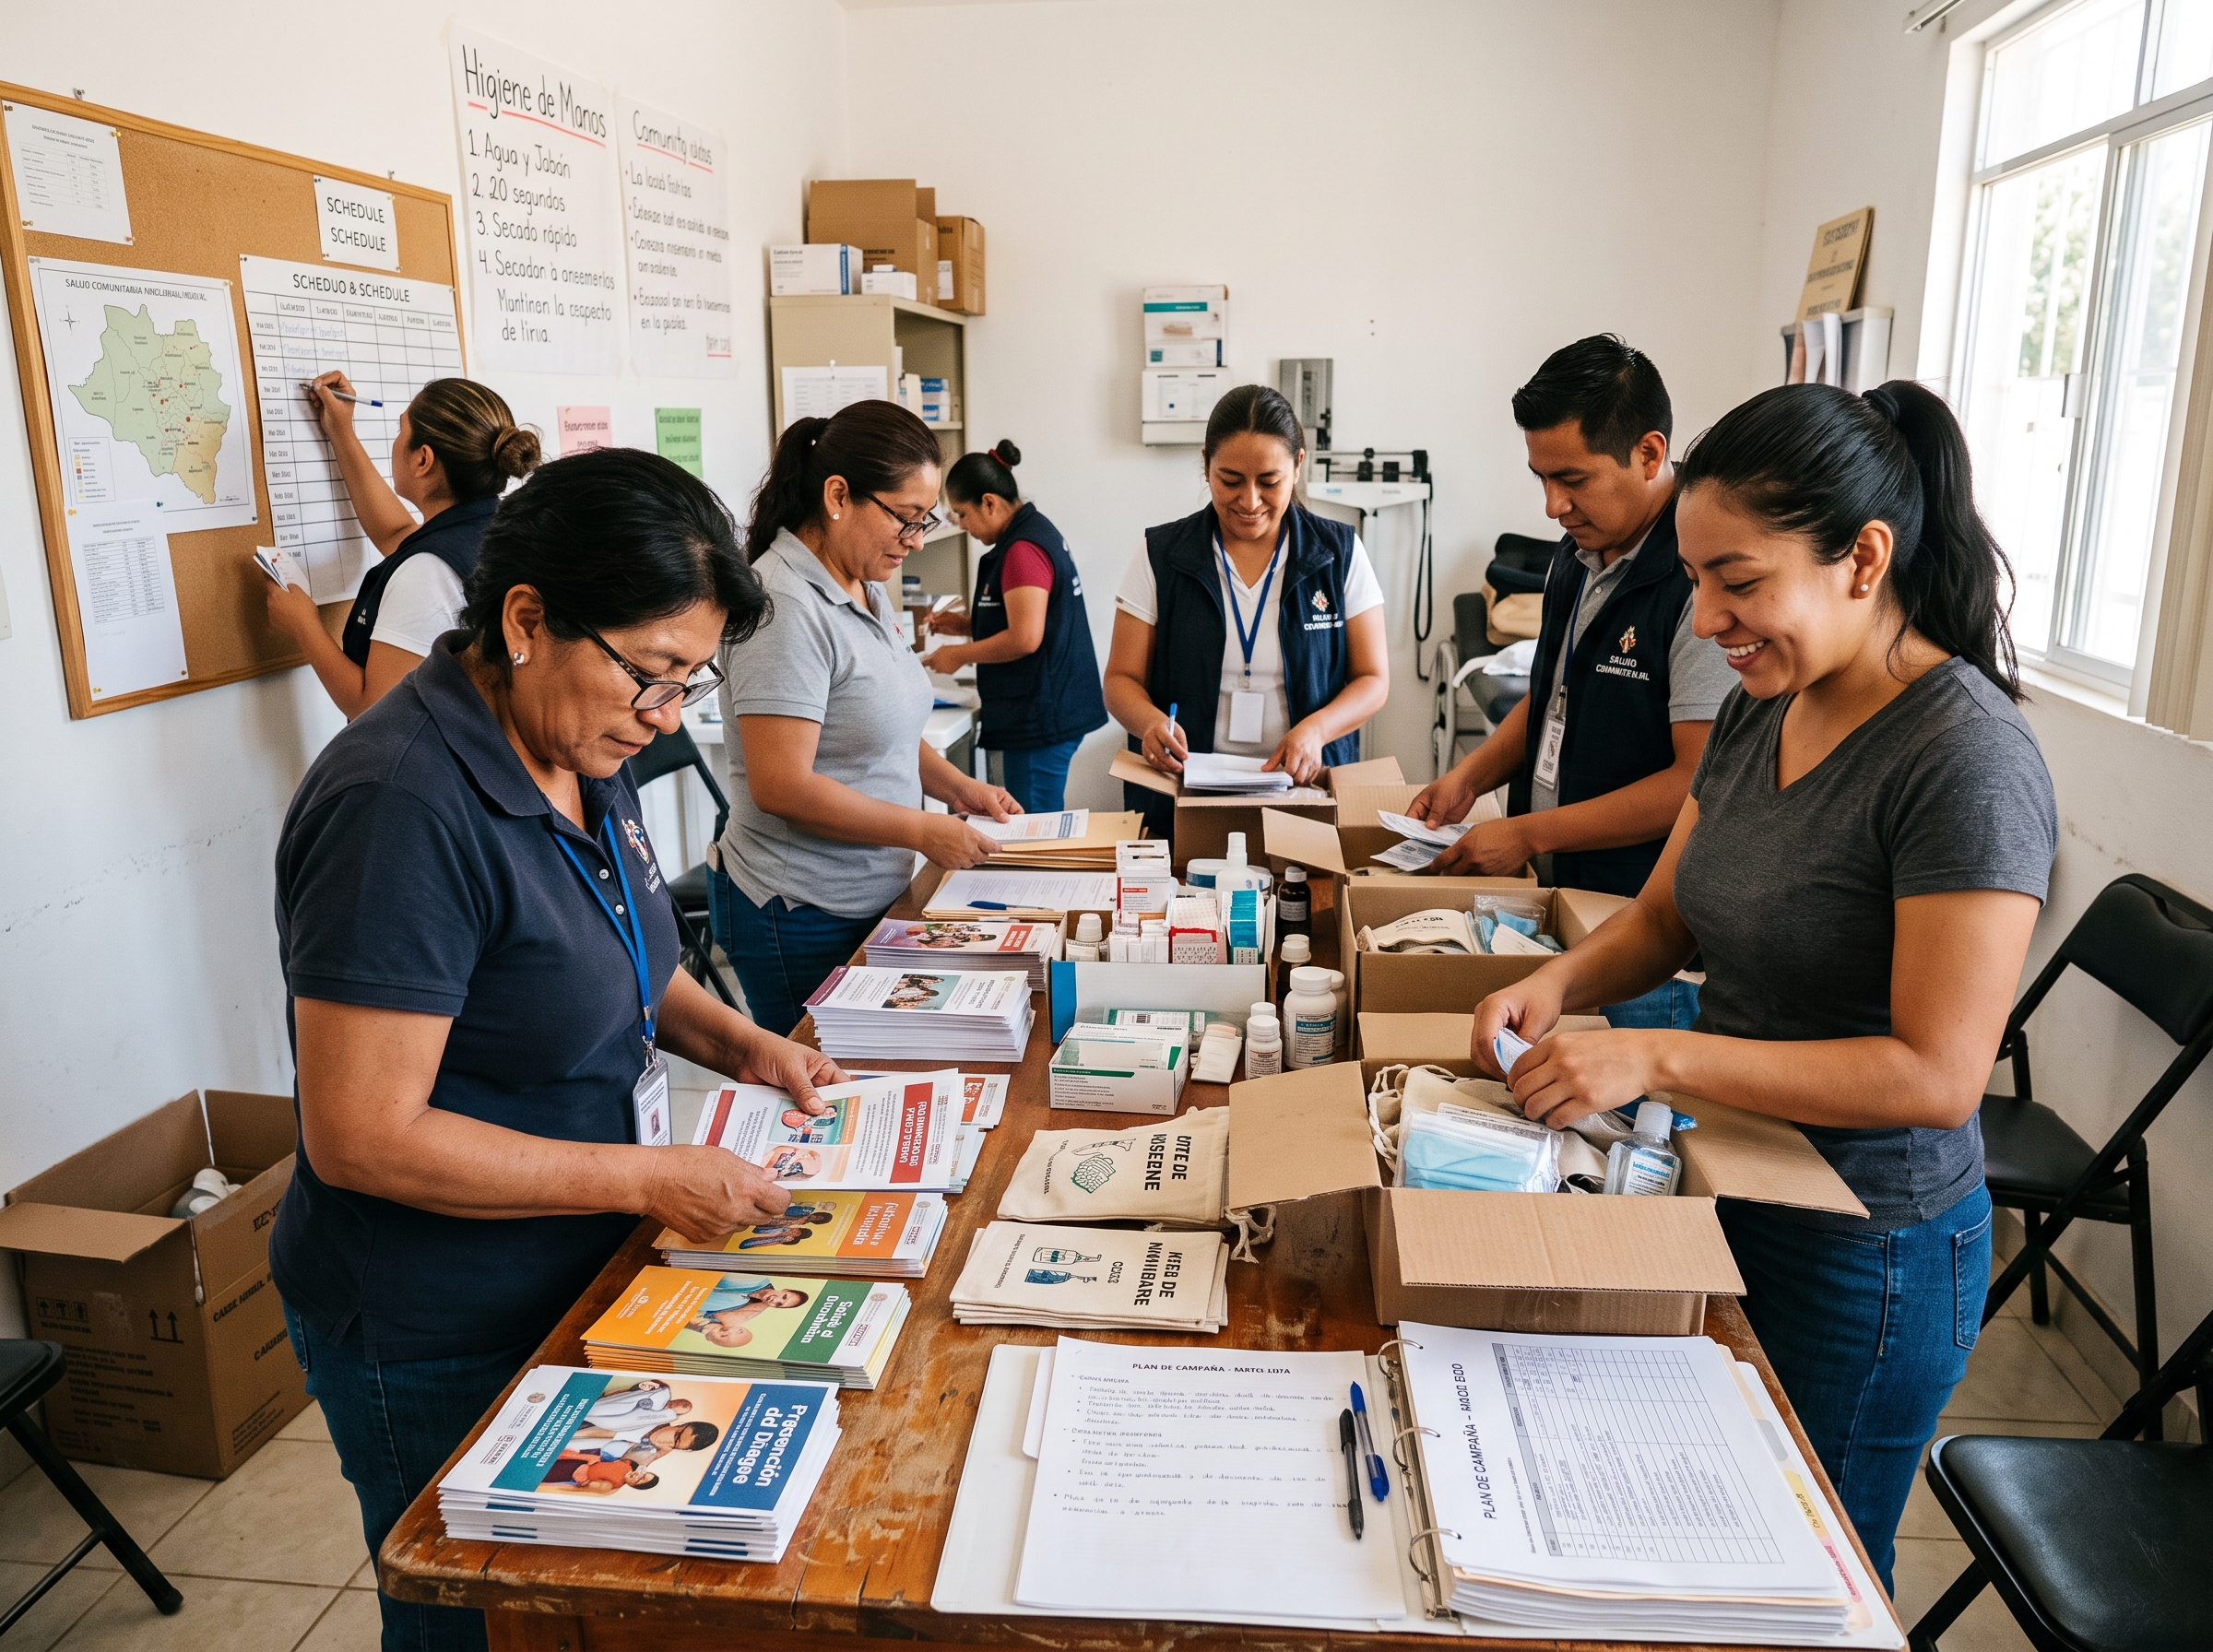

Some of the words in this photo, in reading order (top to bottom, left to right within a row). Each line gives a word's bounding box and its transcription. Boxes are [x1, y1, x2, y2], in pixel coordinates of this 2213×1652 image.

[462, 44, 532, 119] Higiene
[538, 75, 555, 118] de
[559, 80, 606, 137] Manos
[468, 128, 480, 157] 1.
[485, 132, 518, 171] Agua
[523, 152, 529, 177] y
[472, 172, 484, 198] 2.
[490, 175, 507, 202] 20
[513, 186, 565, 216] segundos
[326, 196, 385, 223] SCHEDULE
[330, 227, 386, 252] SCHEDULE
[476, 210, 489, 236] 3.
[493, 212, 538, 242] Secado
[543, 224, 577, 253] rápido
[479, 249, 491, 274] 4.
[292, 274, 347, 295] SCHEDUO
[349, 281, 357, 296] &
[360, 283, 410, 302] SCHEDULE
[502, 318, 516, 341] de
[1171, 1164, 1188, 1180] DE
[1159, 1280, 1177, 1298] DE
[1462, 1423, 1486, 1473] CAMPAÑA
[1480, 1492, 1497, 1519] PLAN
